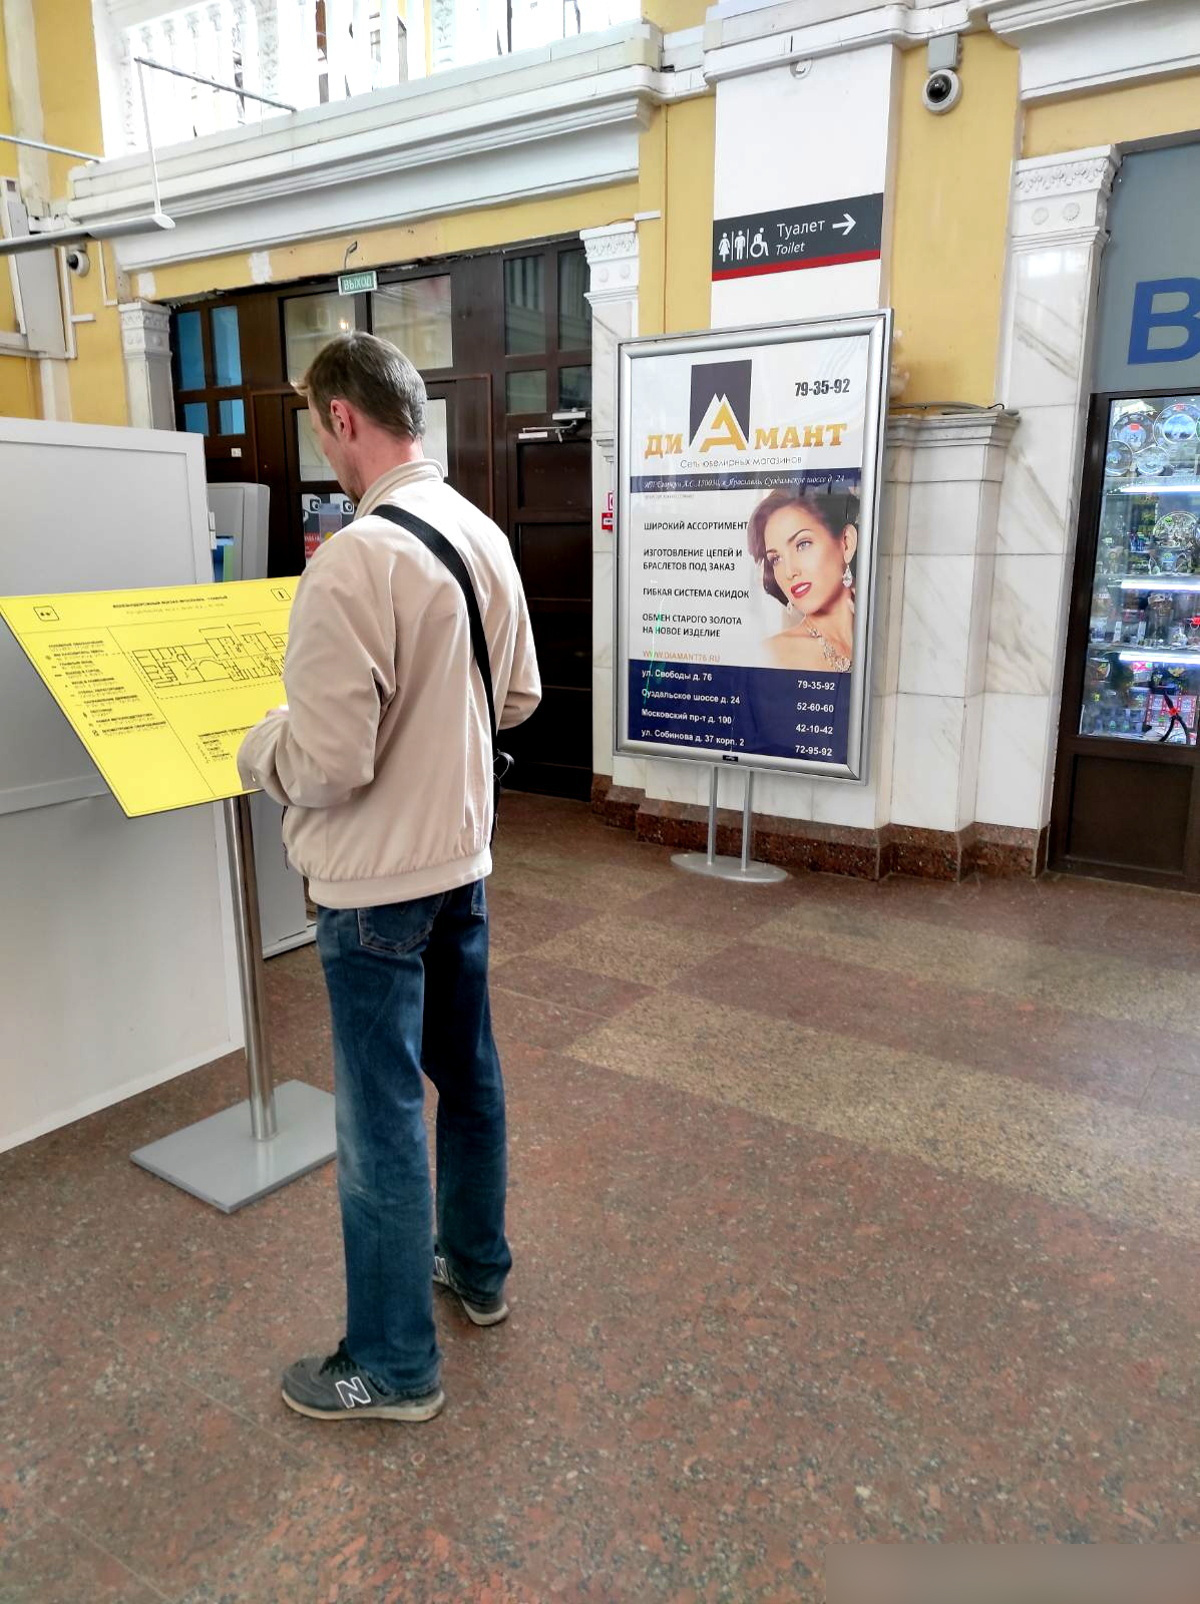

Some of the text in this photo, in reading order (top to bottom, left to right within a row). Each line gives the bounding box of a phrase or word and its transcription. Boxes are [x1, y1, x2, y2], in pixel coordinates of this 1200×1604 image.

[776, 220, 825, 241] Туалет
[776, 242, 805, 256] Toilet
[343, 275, 372, 290] ВЫХОД
[795, 378, 850, 397] 79-35-92
[703, 459, 750, 469] ювелирных
[752, 456, 802, 466] магазинов
[644, 521, 748, 530] ШИРОКИЙ АССОРТИМЕНТ
[643, 547, 743, 558] ИЗГОТОВЛЕНИЕ ЦЕПЕЙ И
[643, 561, 735, 572] БРАСЛЕТОВ ПОД ЗАКАЗ
[643, 588, 750, 599] ГИБКАЯ СИСТЕМА СКИДОК
[642, 613, 743, 626] ОБМЕН СТАРОГО ЗОЛОТА
[642, 626, 721, 638] НА НОВОЕ ИЗДЕЛИЕ
[641, 670, 653, 678] ул.
[655, 669, 691, 680] Свободы
[702, 673, 713, 681] 76
[797, 680, 836, 691] 79-35-92
[693, 694, 719, 702] шоссе
[720, 696, 729, 704] д.
[730, 696, 740, 704] 24
[796, 702, 835, 713] 52-60-60
[641, 708, 732, 724] Московский пр-т д. 100
[795, 723, 834, 735] 42-10-42
[641, 729, 745, 747] ул. Собинова д. 37 корп. 2
[795, 745, 833, 756] 72-95-92
[335, 1376, 372, 1409] N
